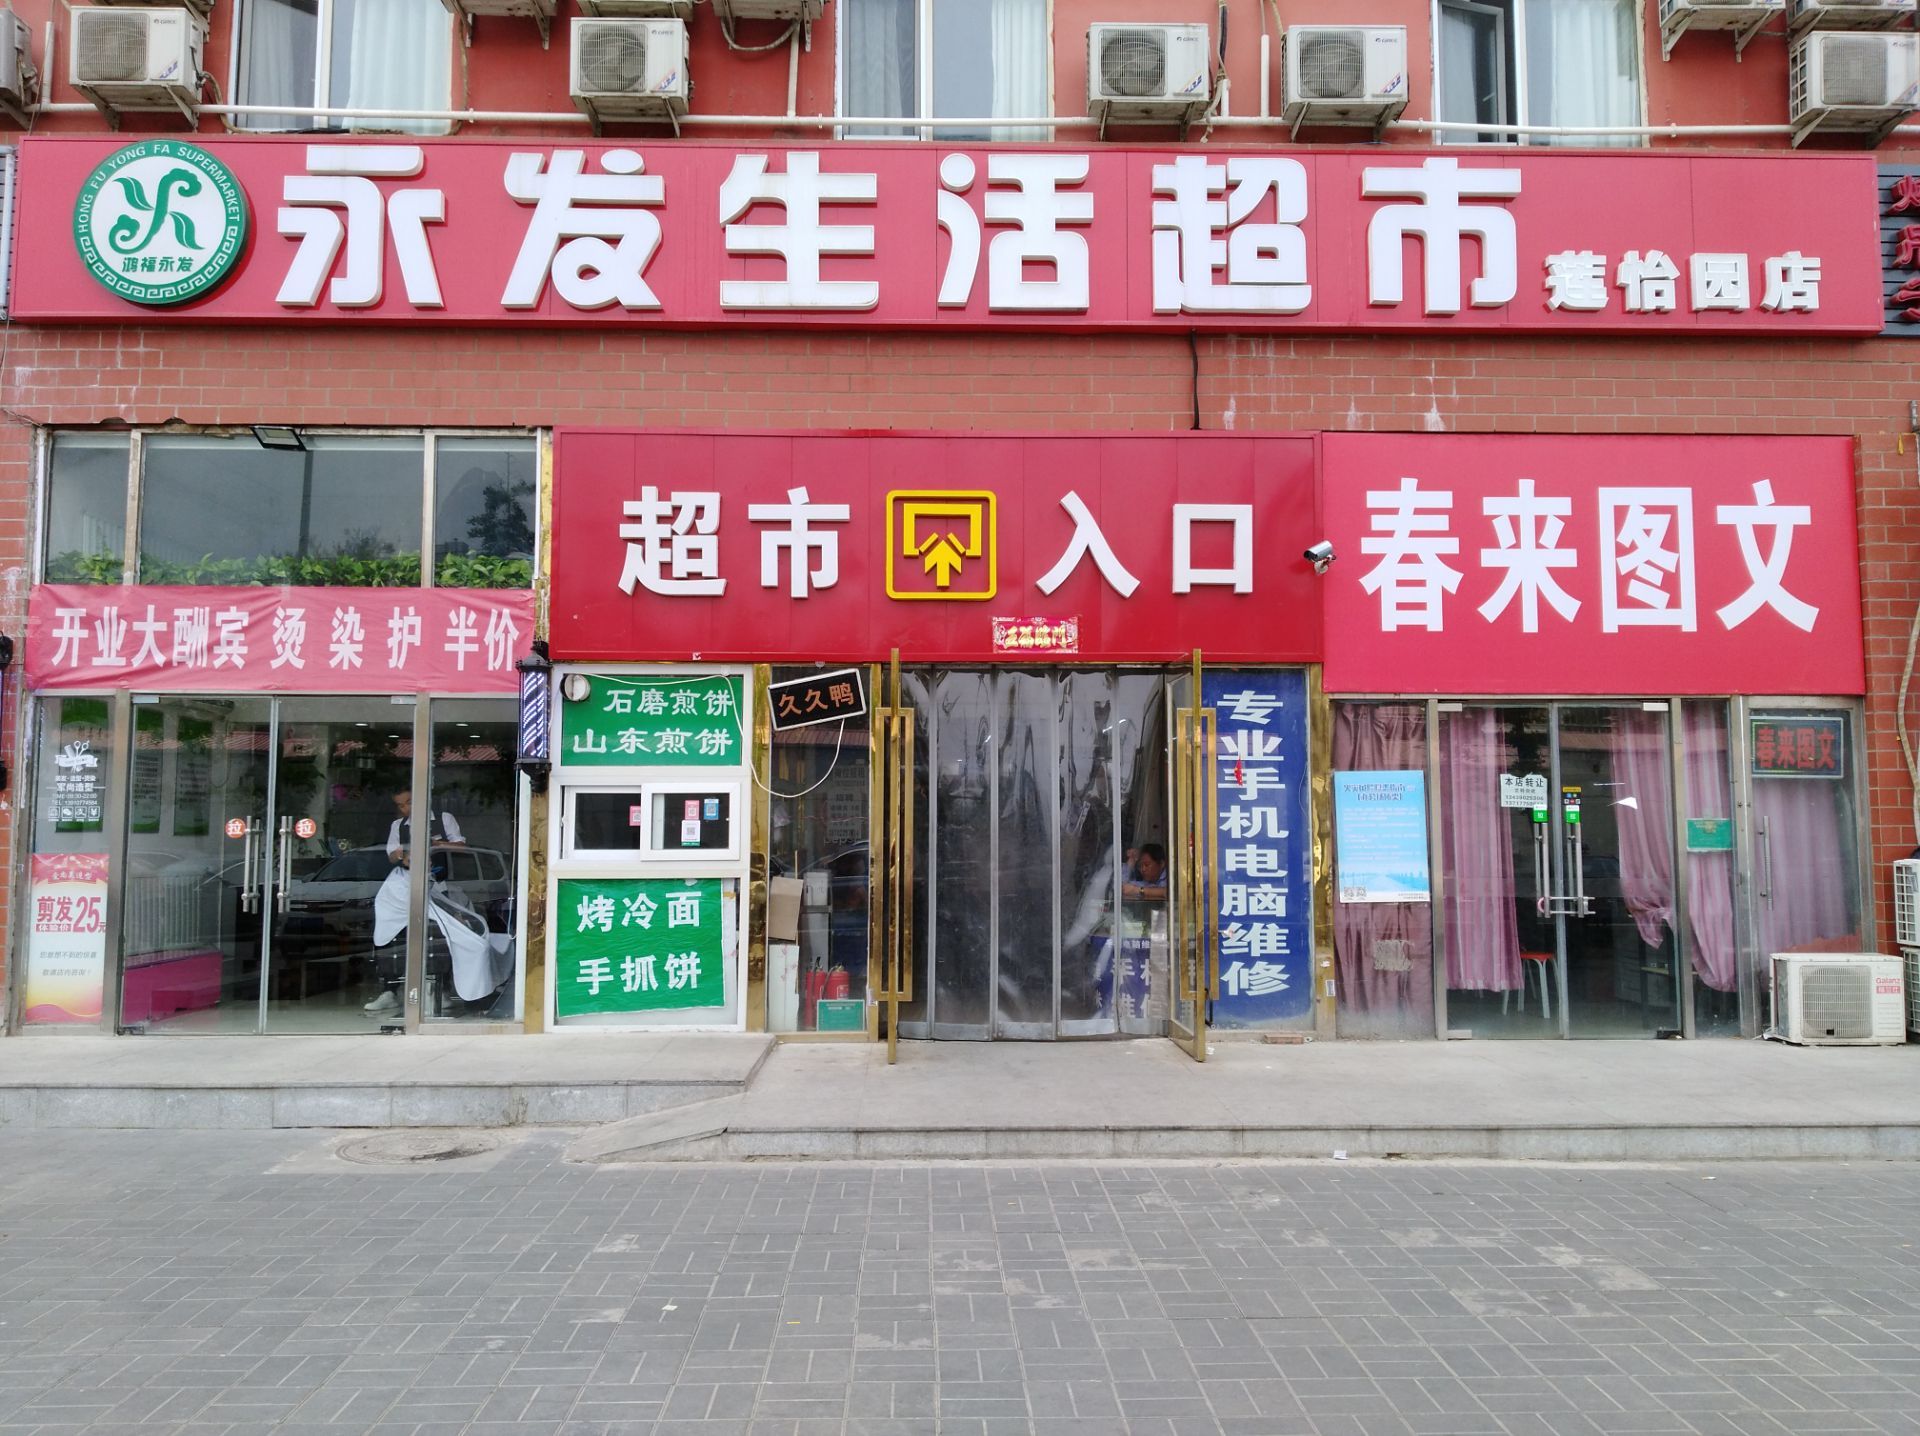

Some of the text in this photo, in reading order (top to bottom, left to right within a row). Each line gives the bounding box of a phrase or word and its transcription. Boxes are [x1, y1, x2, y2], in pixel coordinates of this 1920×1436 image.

[78, 144, 240, 233] HONG FU YONG FA SUPERMARKET
[275, 145, 1521, 317] 永发生活超市
[122, 257, 194, 273] 鸿福永发
[617, 485, 1254, 600] 超市 入口
[1358, 477, 1820, 634] 春来图文
[51, 604, 520, 672] 开业大酬宾 烫 染 护 半价
[603, 688, 733, 718] 石磨煎饼
[778, 682, 856, 718] 久久鸭
[573, 728, 733, 757] 山东煎饼
[1756, 726, 1836, 770] 春来图文
[1505, 777, 1544, 788] 本店转让
[227, 821, 243, 836] 拉
[297, 821, 313, 836] 拉
[1216, 690, 1290, 997] 专业手机电脑维修
[576, 890, 702, 934] 烤冷面
[575, 951, 702, 996] 手抓饼
